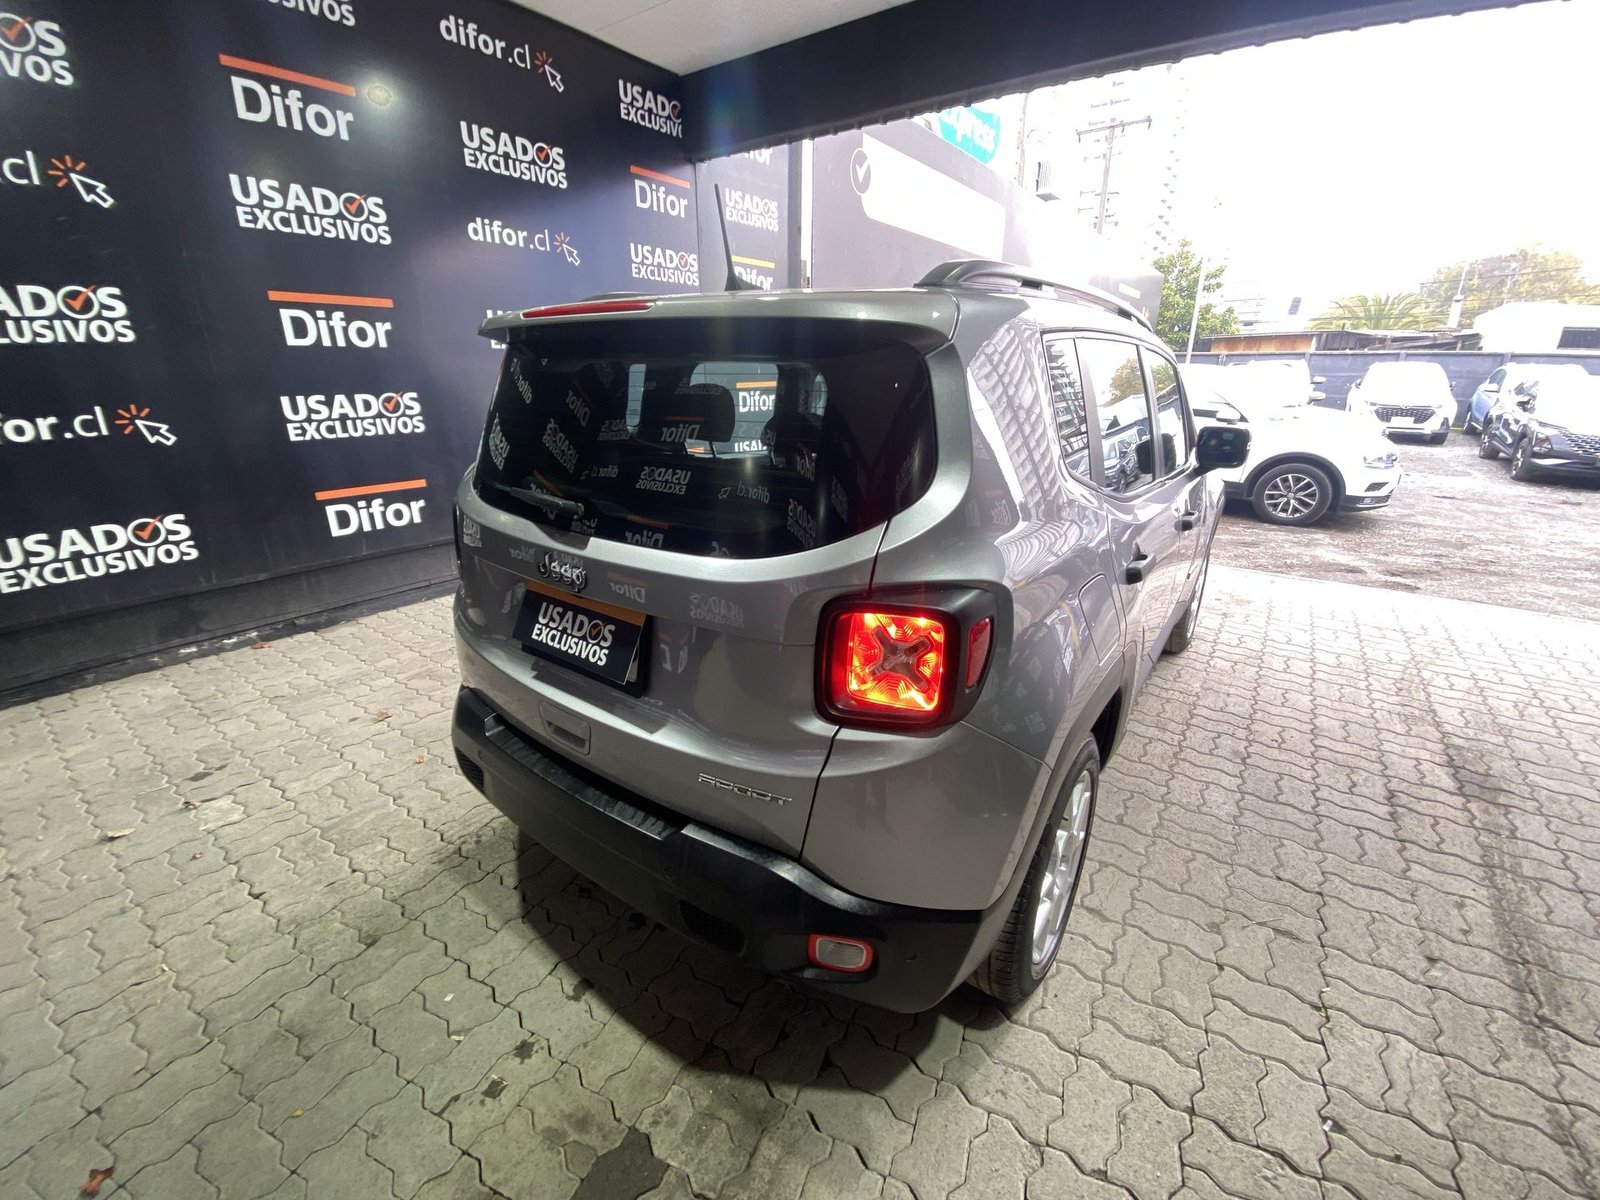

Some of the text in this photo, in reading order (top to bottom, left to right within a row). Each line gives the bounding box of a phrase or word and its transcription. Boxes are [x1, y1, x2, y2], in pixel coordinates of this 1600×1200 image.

[440, 15, 530, 69] difor.cl
[230, 76, 354, 141] Difor
[460, 121, 565, 170] USADOS
[0, 151, 40, 185] cl
[464, 148, 568, 189] EXCLUSIVOS
[229, 174, 387, 224] USADOS
[634, 179, 688, 218] Difor
[725, 188, 779, 218] USADOS
[236, 206, 392, 245] EXCLUSIVOS
[467, 217, 550, 251] difor.cl
[726, 206, 779, 232] EXCLUSIVOS
[630, 243, 697, 271] USADOS
[632, 263, 699, 287] EXCLUSIVOS
[279, 308, 392, 348] Difor
[0, 406, 109, 443] or.cl
[280, 392, 421, 421] USADOS
[287, 416, 425, 441] EXCLUSIVOS
[325, 499, 426, 538] Difor
[0, 514, 191, 569] USADOS
[0, 541, 199, 593] EXCLUSIVOS
[538, 602, 616, 647] USADOS
[531, 623, 609, 666] EXCLUSIVOS
